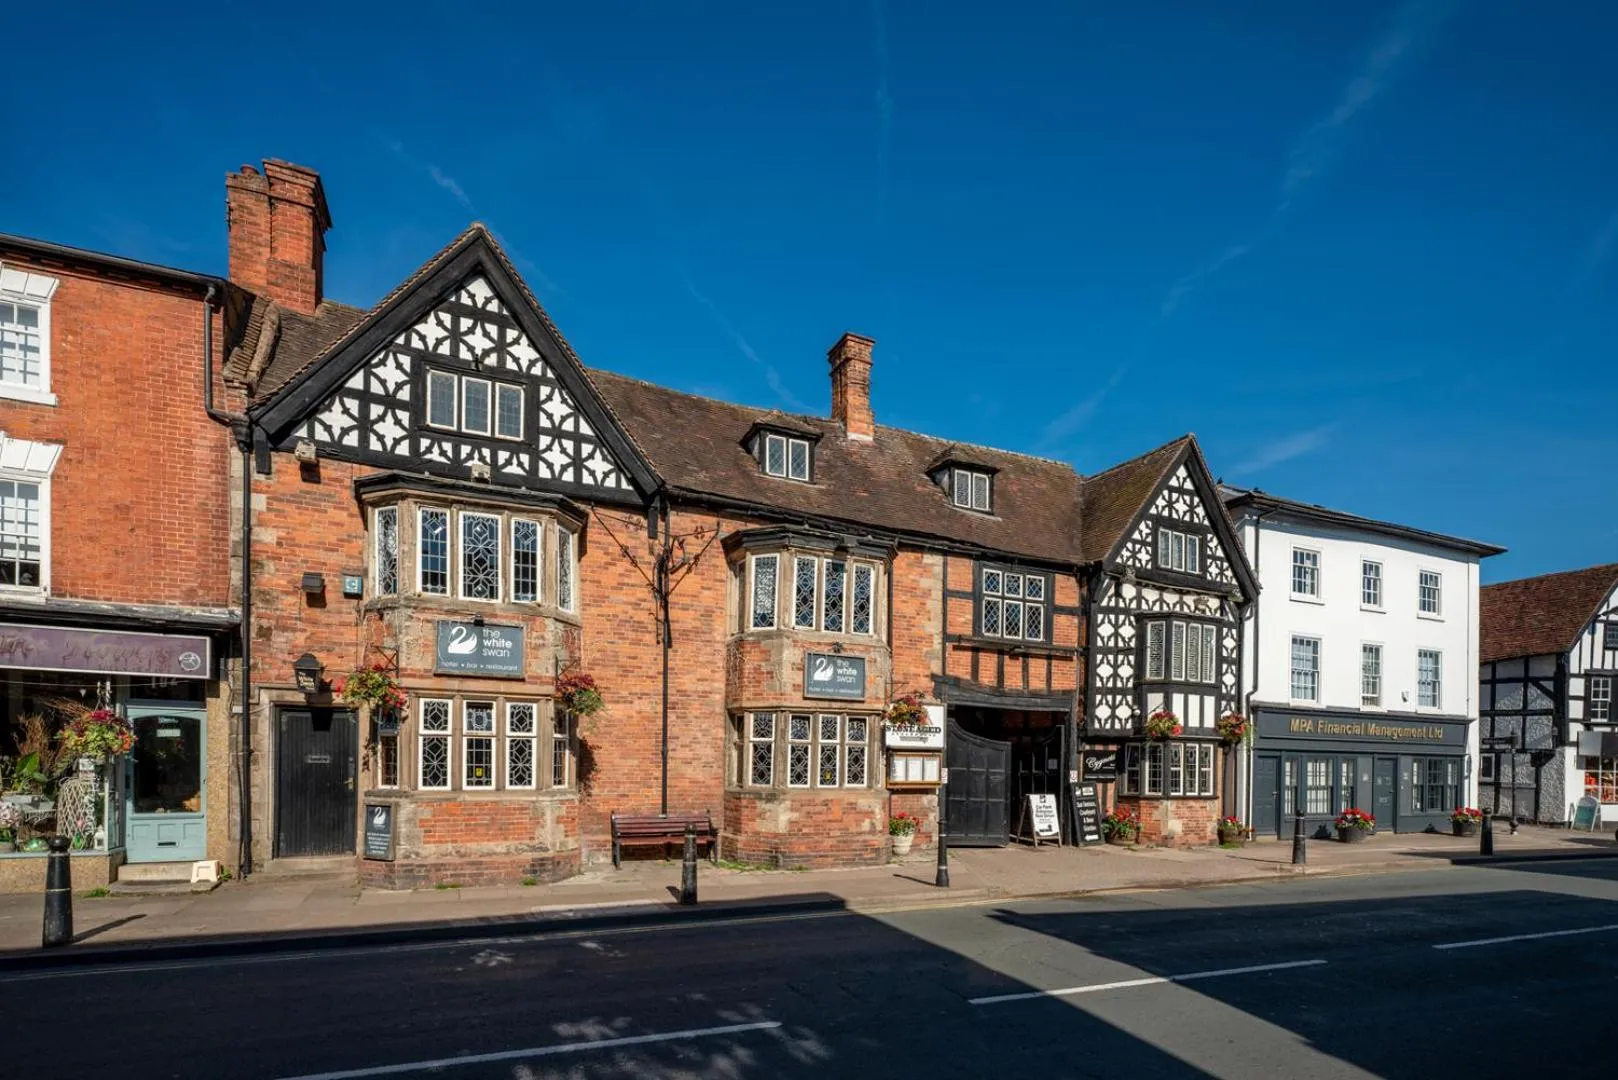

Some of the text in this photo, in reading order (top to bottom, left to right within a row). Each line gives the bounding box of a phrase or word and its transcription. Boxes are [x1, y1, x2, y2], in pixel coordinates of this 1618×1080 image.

[482, 628, 501, 639] the
[482, 638, 513, 649] white
[482, 647, 510, 658] swan
[836, 659, 850, 667] the
[836, 667, 858, 676] white
[836, 675, 856, 683] swan
[1290, 717, 1444, 740] MPA Financial Management Ltd
